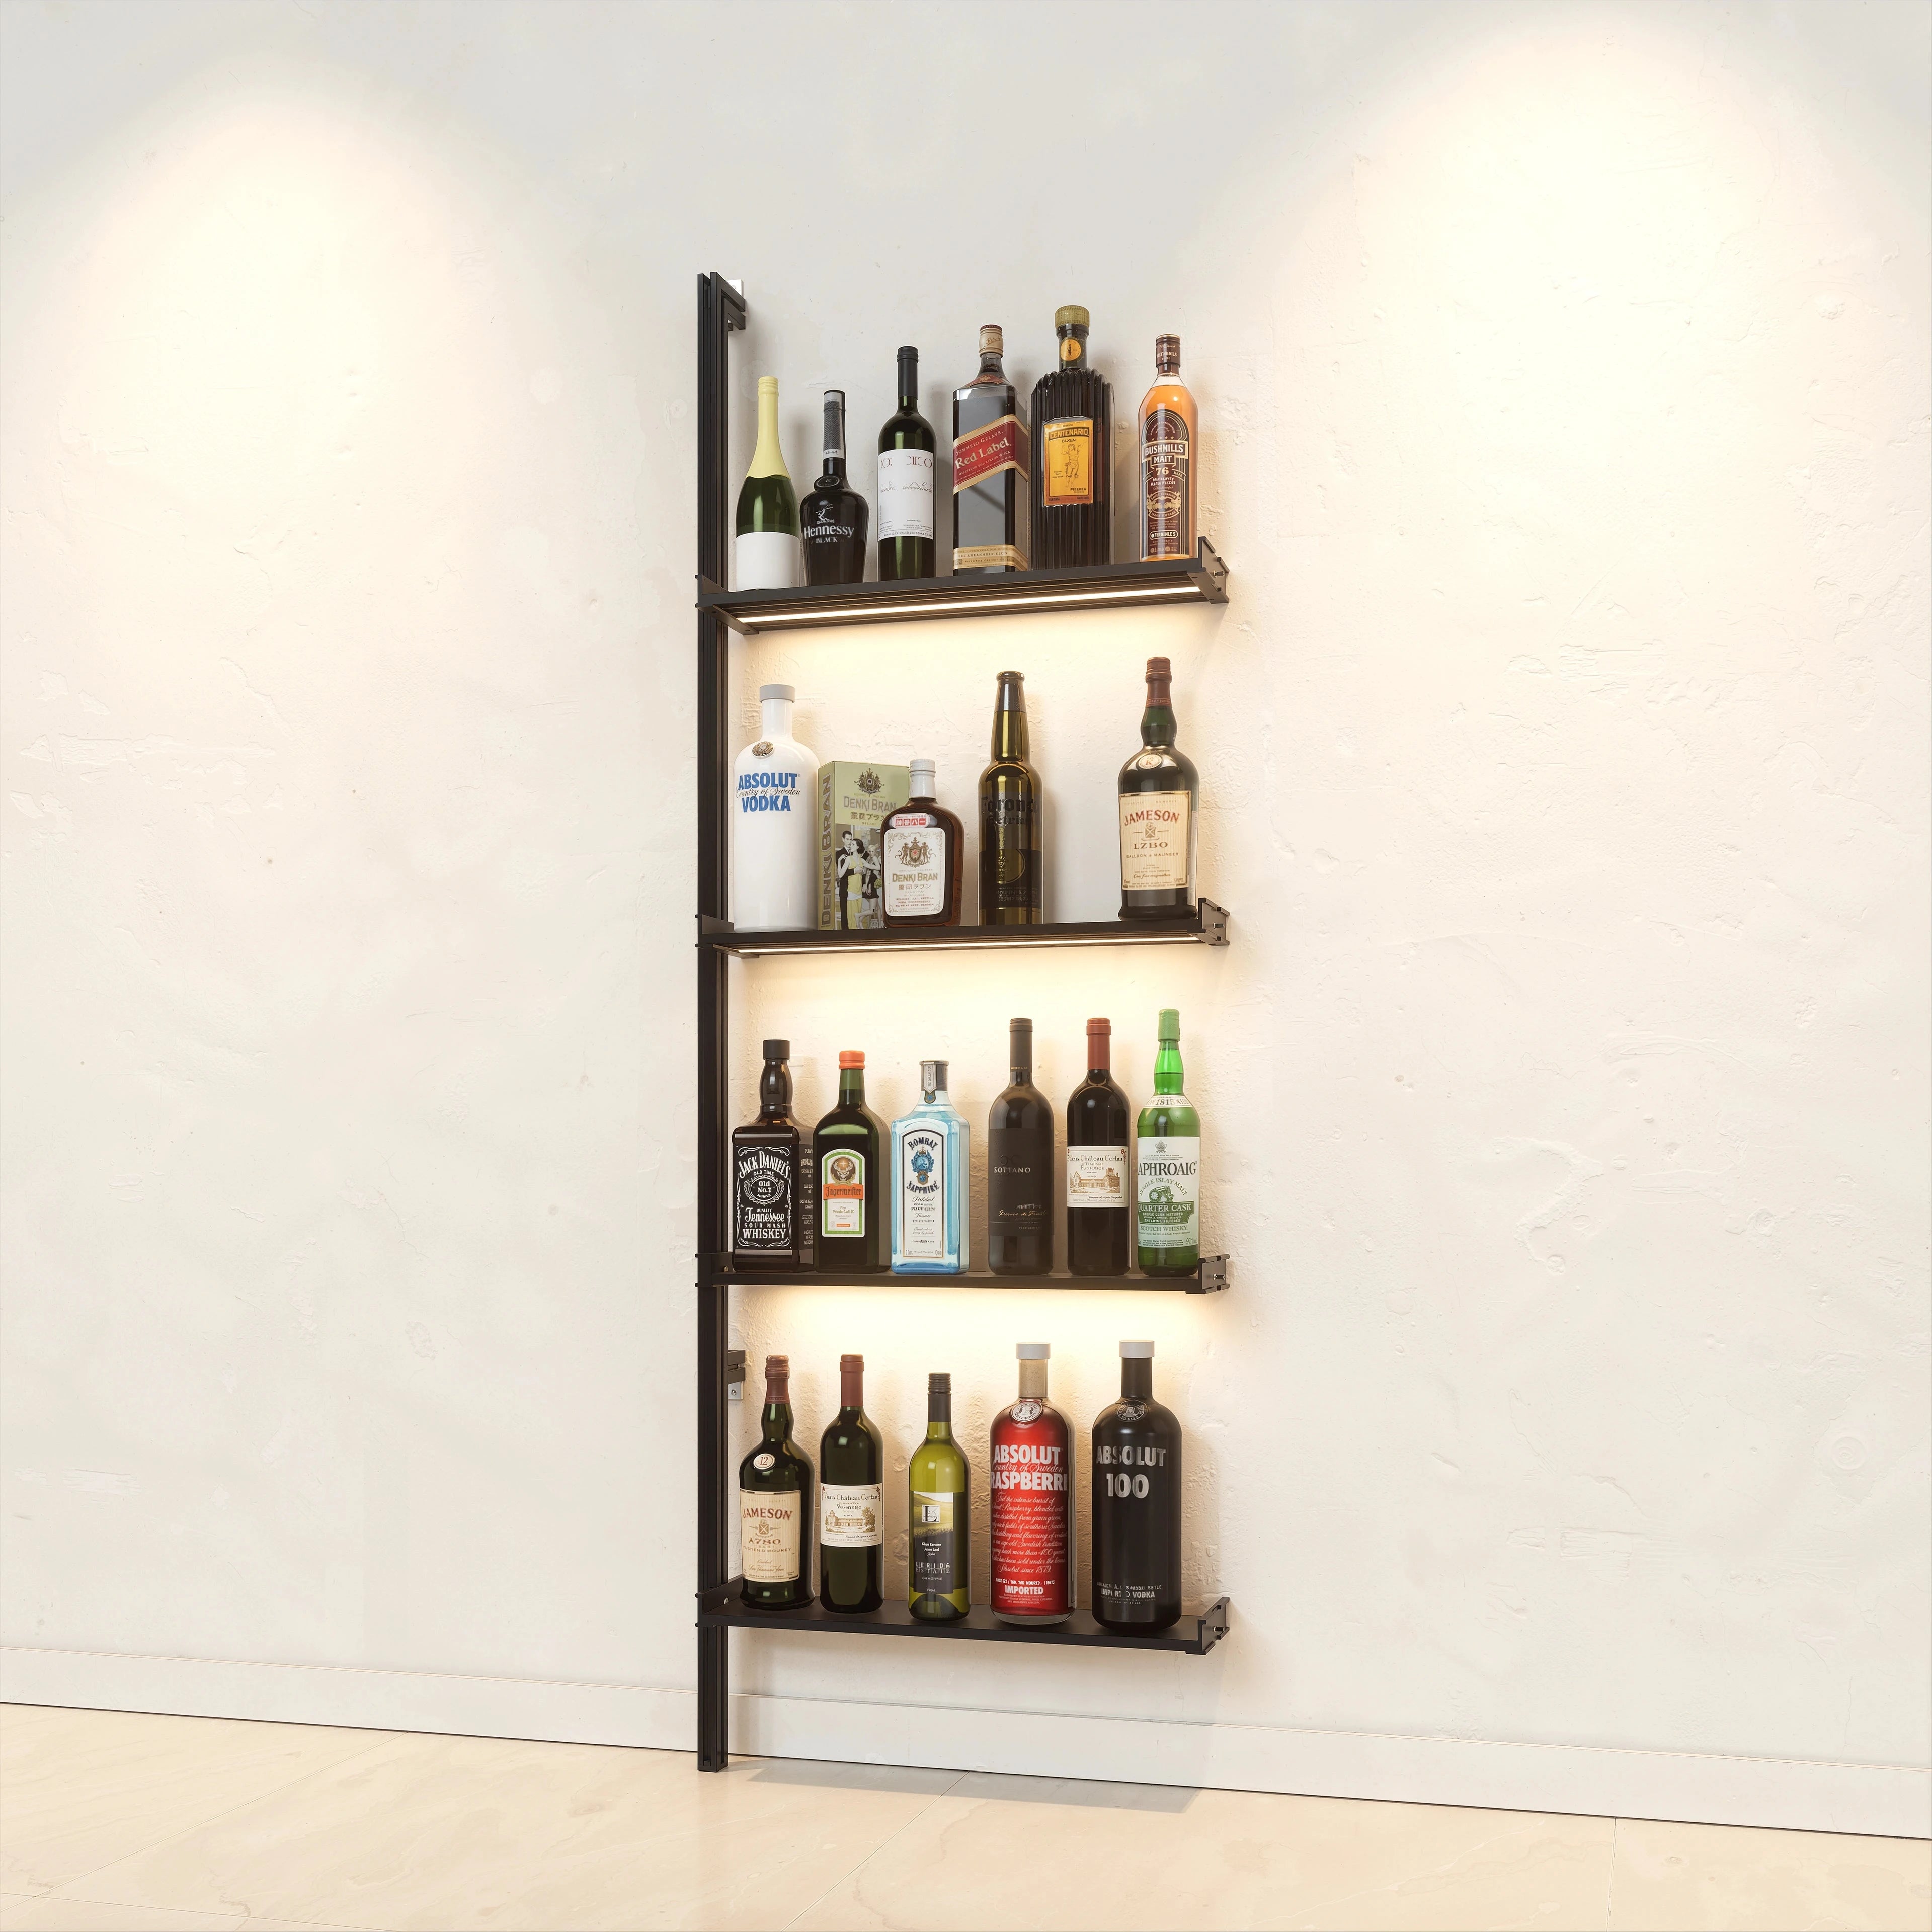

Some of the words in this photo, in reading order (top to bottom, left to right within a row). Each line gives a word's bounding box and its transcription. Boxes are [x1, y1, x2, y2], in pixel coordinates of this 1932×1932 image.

[1145, 444, 1183, 456] BUSHMILLS
[954, 452, 978, 469] Red
[1156, 467, 1169, 475] 76
[804, 525, 854, 539] Hennessy
[738, 772, 797, 790] ABSOLUT
[760, 786, 770, 799] of
[770, 785, 800, 796] Sweden
[742, 795, 791, 813] VODKA
[843, 796, 870, 812] DENKI
[1124, 810, 1180, 826] JAMESON
[892, 873, 916, 882] DENKI
[917, 872, 938, 881] BRAN
[908, 1137, 938, 1151] BOMBAY
[738, 1156, 759, 1178] JACK
[759, 1151, 791, 1178] DANIEL'S
[906, 1180, 940, 1194] SAPPHIRE
[1173, 1181, 1188, 1195] MALT
[1138, 1204, 1170, 1212] QUARTER
[1171, 1203, 1191, 1212] CASK
[745, 1208, 785, 1222] Tennessee
[743, 1229, 786, 1239] WHISKEY
[759, 1456, 769, 1465] 12
[994, 1444, 1061, 1465] ABSOLUT
[1096, 1445, 1166, 1466] ABSOLUT
[1019, 1462, 1029, 1472] of
[1030, 1462, 1063, 1473] Sweden
[991, 1471, 1067, 1491] RASPBERRI
[1106, 1473, 1149, 1499] 100
[743, 1507, 793, 1521] JAMESON
[1005, 1585, 1044, 1595] IMPORTED
